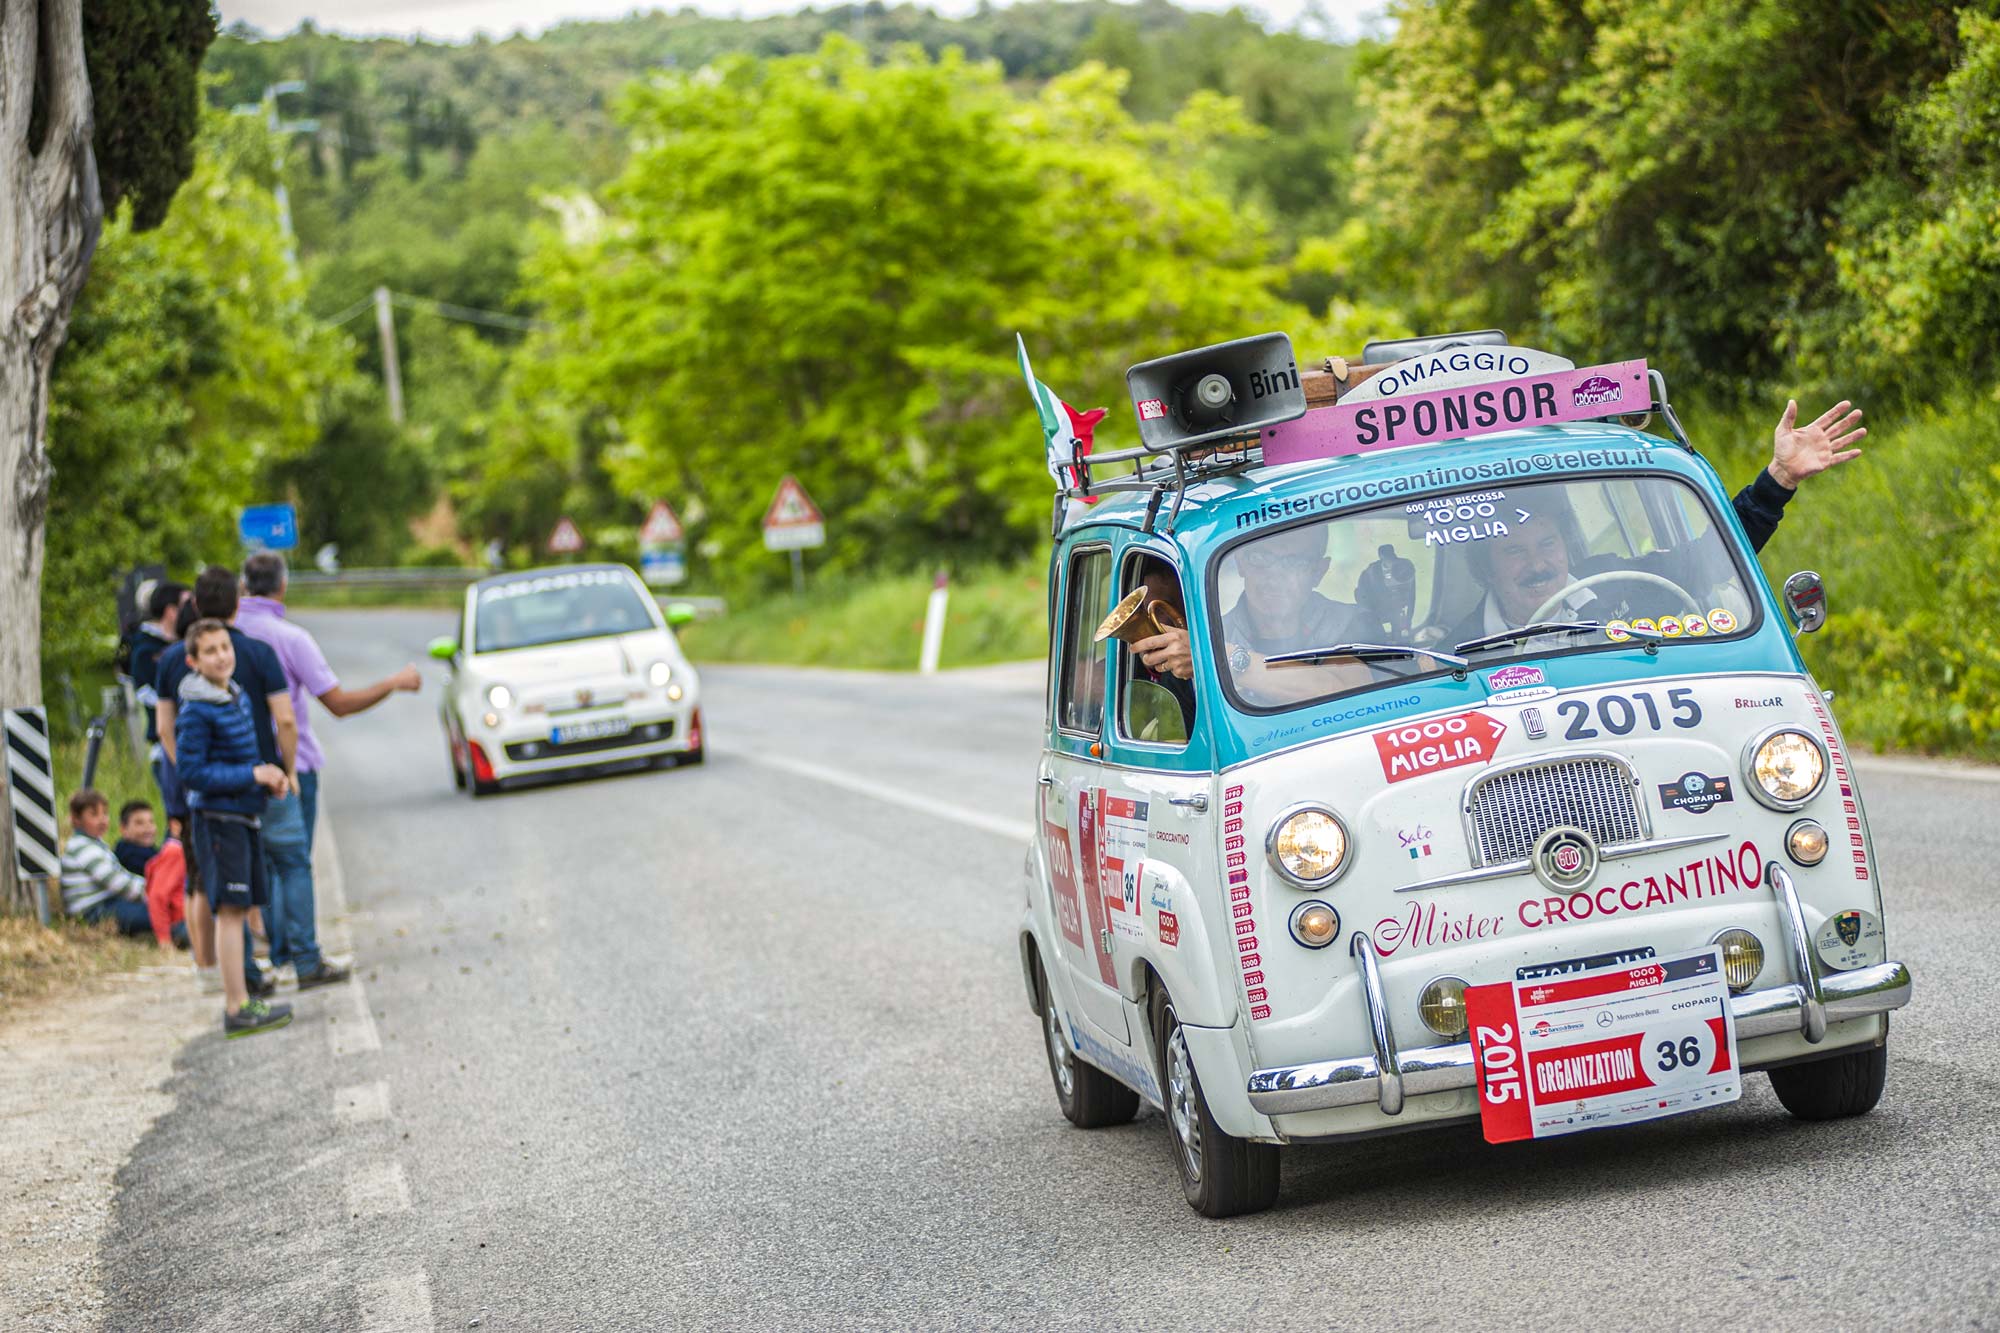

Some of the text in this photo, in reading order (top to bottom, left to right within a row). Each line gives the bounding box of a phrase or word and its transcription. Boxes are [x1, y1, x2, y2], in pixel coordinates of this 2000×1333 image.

[1248, 362, 1299, 400] Bini
[1378, 353, 1529, 396] OMAGGIO
[1575, 387, 1621, 406] CROCCANTINO
[1355, 382, 1558, 445] SPONSOR
[1235, 449, 1655, 530] mistercroccantinosalo@teletu.it
[1406, 491, 1506, 514] 600 ALLA RISCOSSA
[1423, 502, 1495, 525] 1000
[1425, 521, 1509, 546] MIGLIA
[1492, 672, 1542, 690] CROCCANTINO
[1252, 695, 1421, 747] Mister CROCCANTINO
[1557, 687, 1702, 740] 2015
[1387, 718, 1467, 748] 1000
[1391, 736, 1482, 776] MIGLIA
[1673, 793, 1721, 806] CHOPARD
[1225, 822, 1240, 832] 1992
[1156, 831, 1190, 845] CROCCANTINO
[1226, 840, 1241, 850] 1993
[1558, 850, 1577, 867] 600
[1124, 873, 1135, 903] 36
[1372, 840, 1762, 958] Mister CROCCANTINO
[1160, 914, 1174, 928] 1000
[1233, 908, 1249, 918] 1997
[1236, 924, 1252, 934] 1998
[1239, 941, 1255, 951] 1999
[1242, 958, 1258, 968] 2000
[1245, 976, 1262, 986] 2001
[1629, 967, 1655, 979] 1000
[1629, 976, 1659, 989] MIGLIA
[1249, 993, 1264, 1003] 2002
[1671, 995, 1718, 1011] CHOPARD
[1252, 1009, 1268, 1019] 2003
[1616, 1008, 1660, 1021] Mercedes-Benz
[1656, 1036, 1701, 1072] 36
[1476, 1023, 1522, 1104] 2015
[1536, 1048, 1636, 1094] ORGANIZATION
